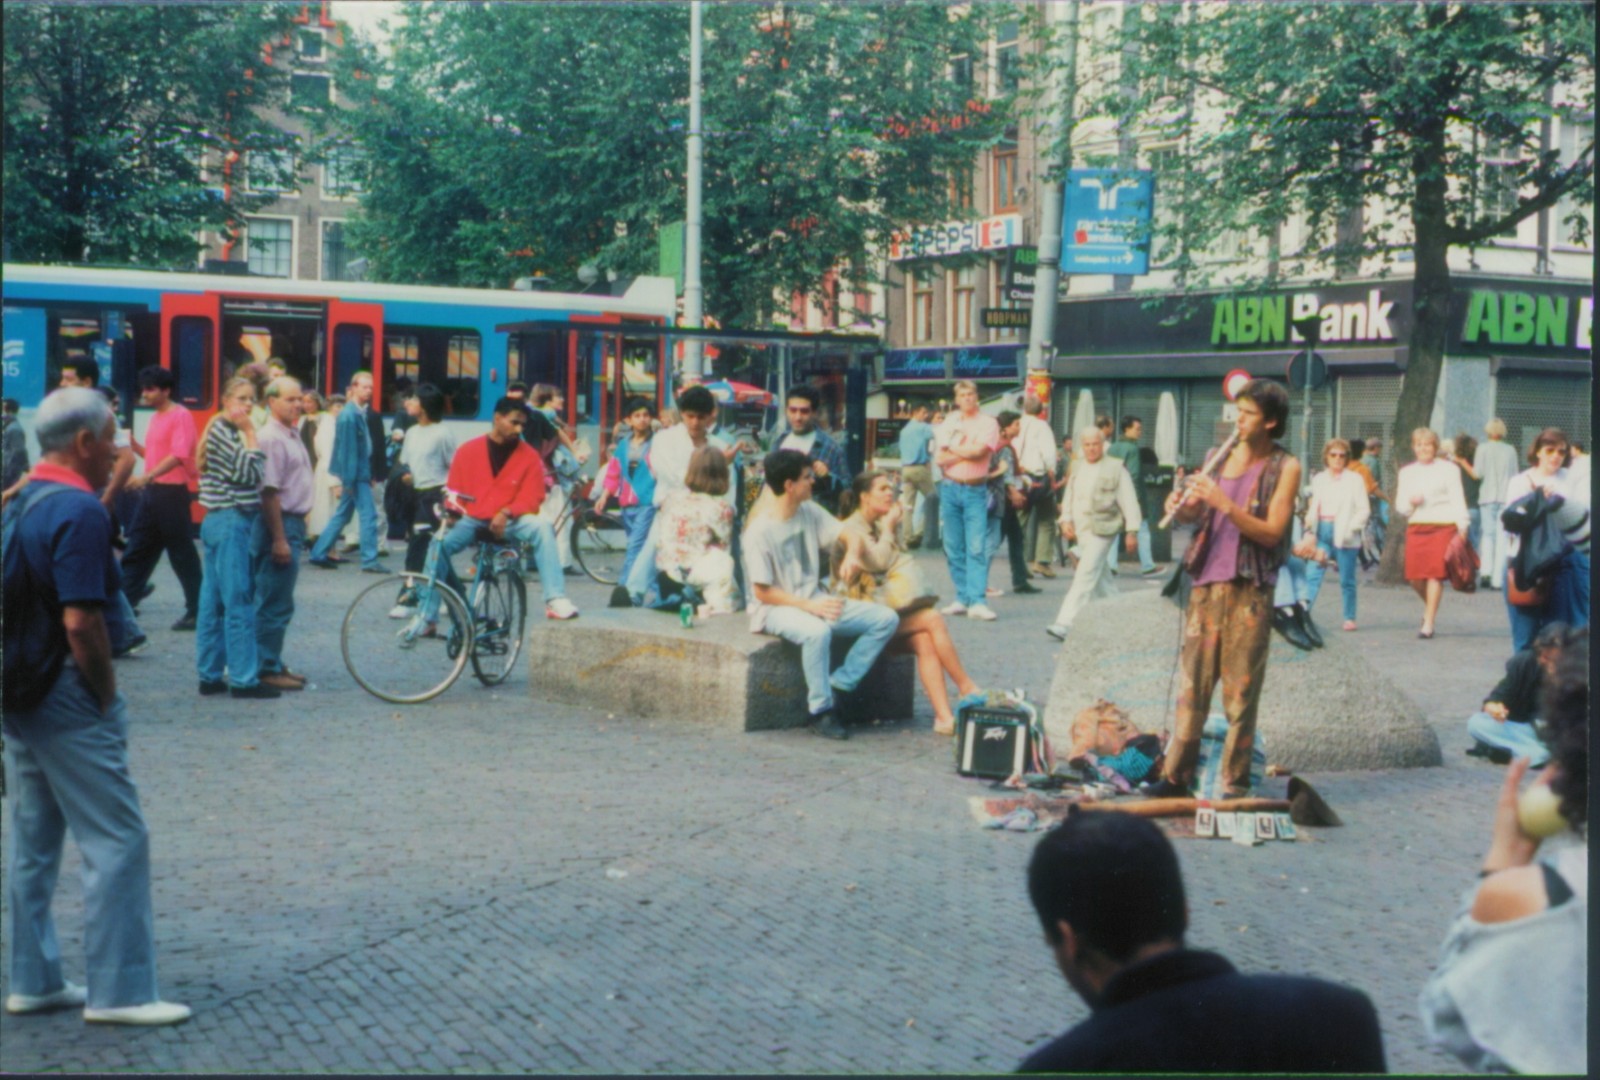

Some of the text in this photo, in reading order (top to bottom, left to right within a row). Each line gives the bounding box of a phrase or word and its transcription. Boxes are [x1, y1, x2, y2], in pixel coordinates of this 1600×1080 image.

[920, 222, 979, 256] PEPSI
[1014, 248, 1038, 265] AB
[1013, 272, 1036, 285] Ban
[1211, 289, 1397, 345] ABN Bank
[1463, 290, 1570, 347] ABN
